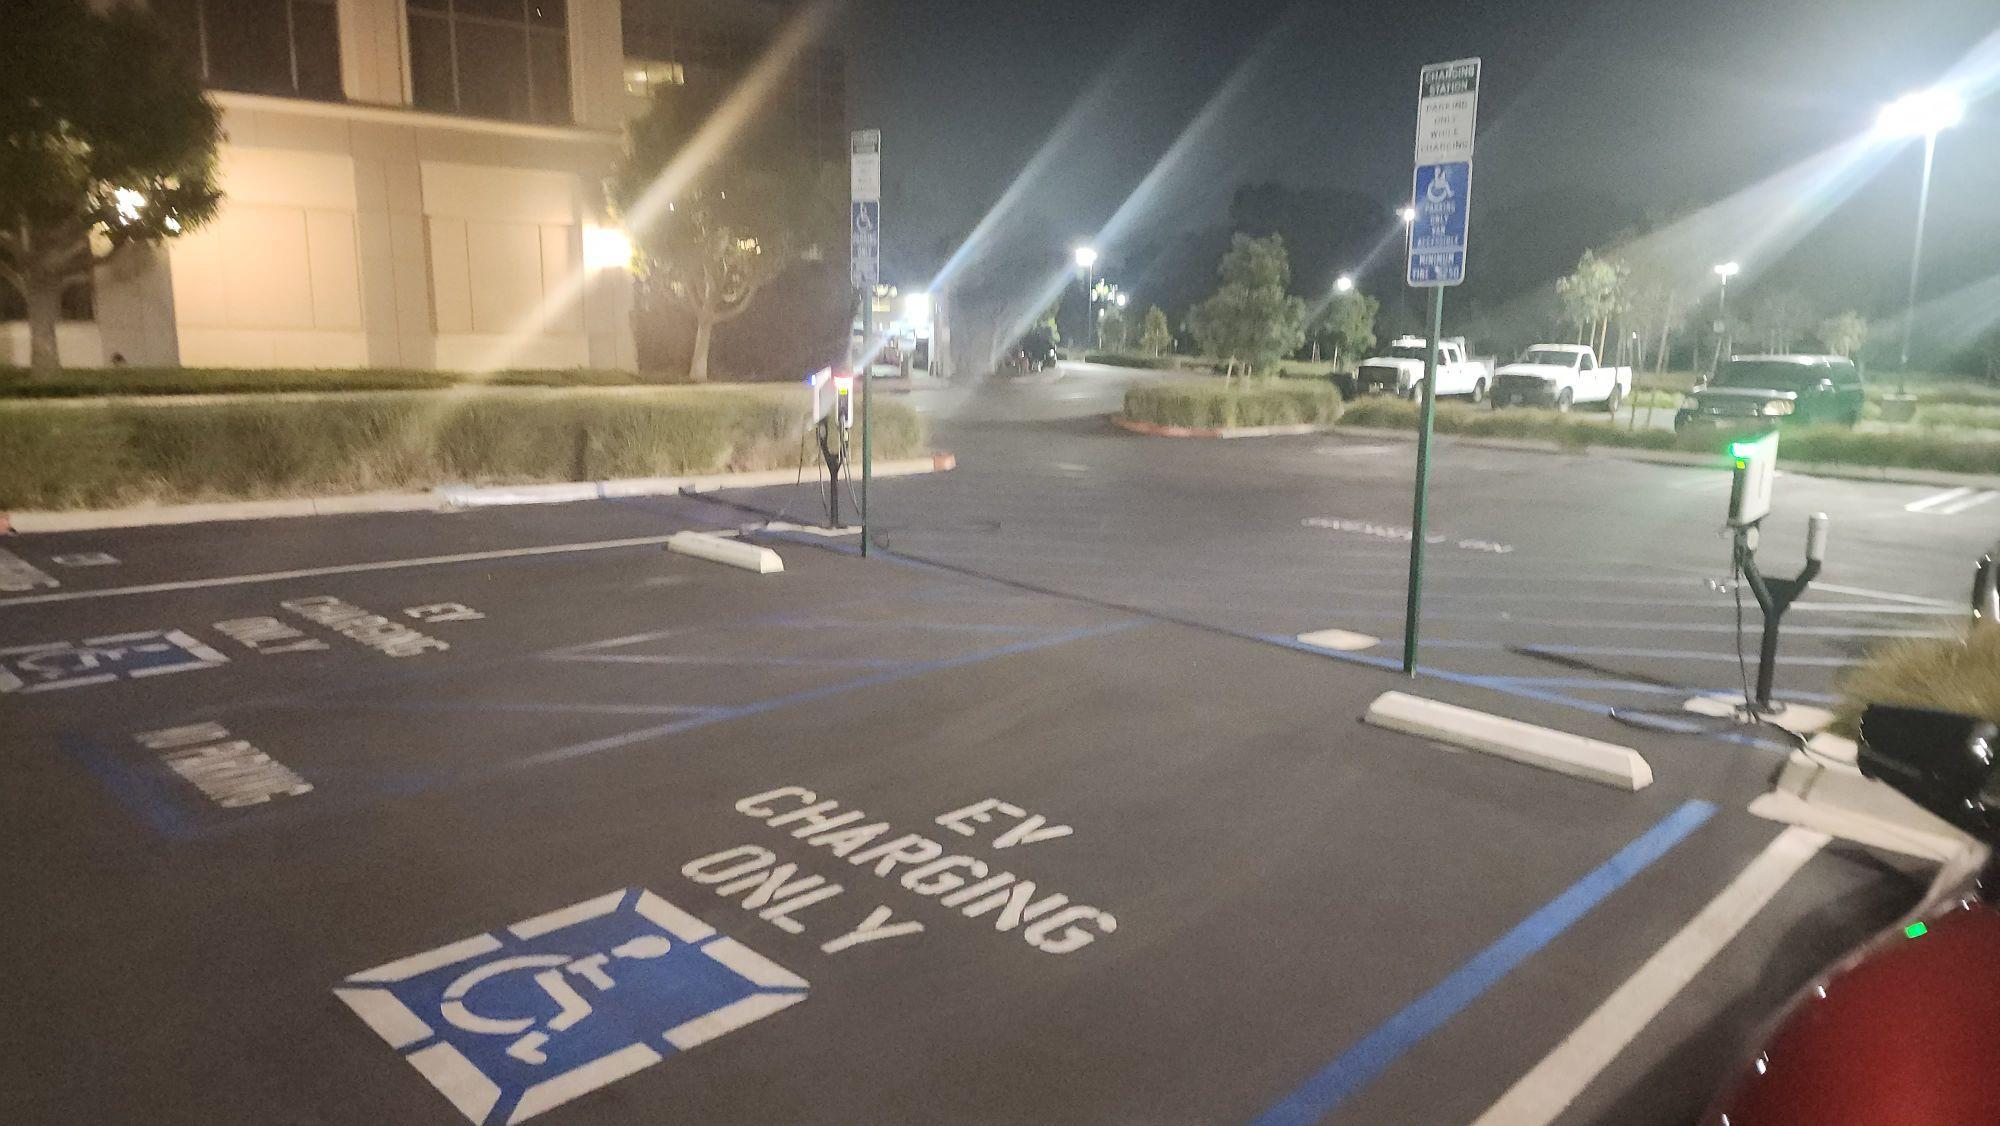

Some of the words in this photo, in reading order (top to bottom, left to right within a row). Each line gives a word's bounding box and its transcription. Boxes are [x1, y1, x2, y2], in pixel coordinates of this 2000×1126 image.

[1424, 64, 1475, 84] CHARGING
[1429, 79, 1468, 96] STATION
[934, 797, 1073, 850] EV
[734, 785, 1118, 955] CHARGING
[681, 843, 926, 955] ONLY
